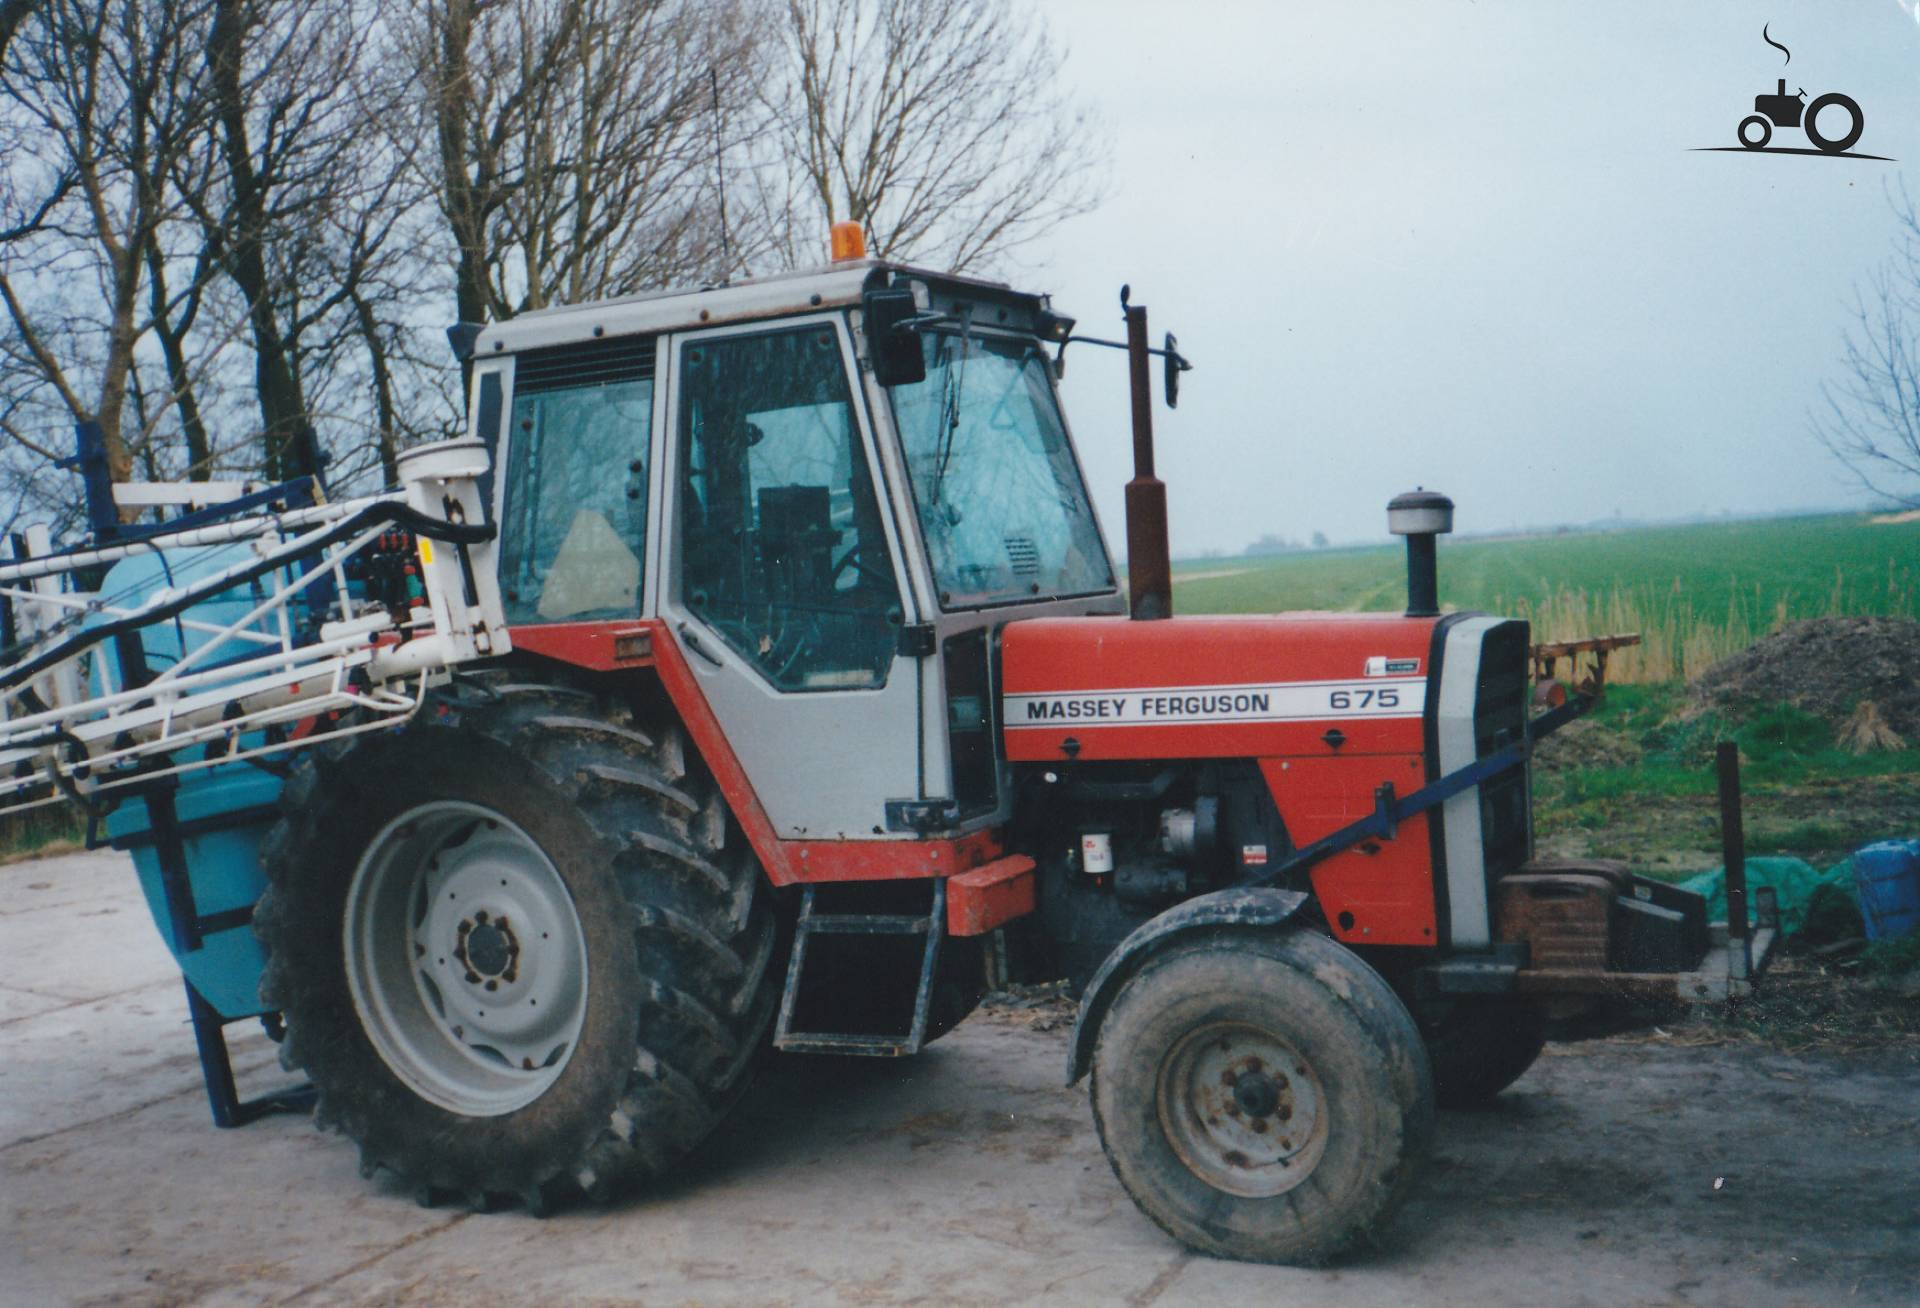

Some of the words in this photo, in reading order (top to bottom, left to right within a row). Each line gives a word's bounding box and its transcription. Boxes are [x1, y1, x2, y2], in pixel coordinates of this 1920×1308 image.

[1027, 699, 1126, 719] MASSEY
[1141, 694, 1270, 716] FERGUSON
[1329, 688, 1400, 709] 675
